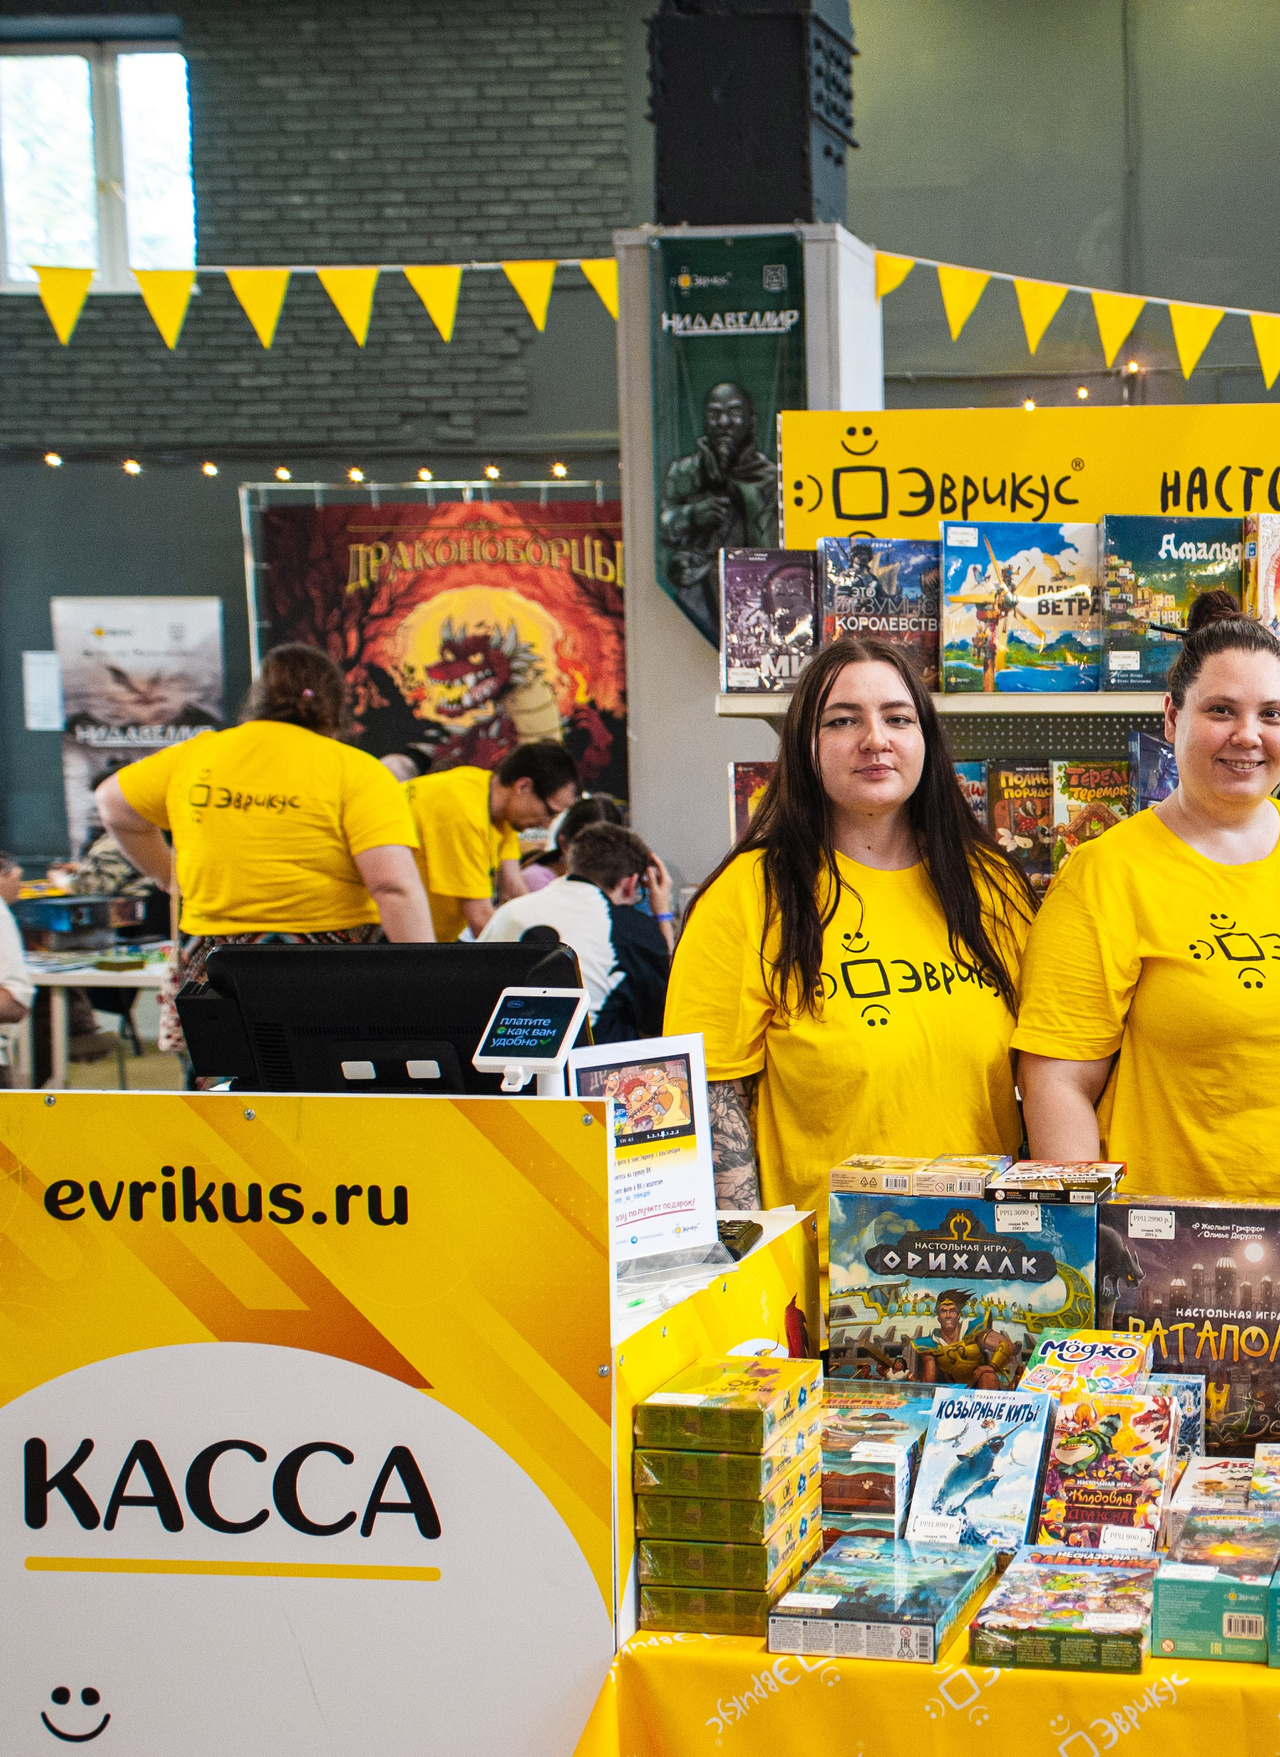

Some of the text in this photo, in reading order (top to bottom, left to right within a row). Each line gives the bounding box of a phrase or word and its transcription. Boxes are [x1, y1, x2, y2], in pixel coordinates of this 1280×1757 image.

[898, 466, 1080, 521] Эврикус
[1158, 532, 1244, 563] Амаль
[346, 534, 625, 593] ДРАКОНОБОРЦЫ
[851, 587, 876, 597] ЭТО
[835, 599, 939, 615] БЕЗУМНО
[835, 617, 940, 631] КОРОЛЕВСТВ
[999, 771, 1051, 788] ПОЛНЫ
[213, 787, 300, 815] Эврикус
[1004, 788, 1051, 799] ПОРЯДО
[895, 959, 1002, 998] Эврику
[500, 1017, 551, 1027] платите
[490, 1035, 539, 1047] удобно
[507, 1028, 557, 1037] как вам
[44, 1166, 409, 1227] evrikus.ru
[628, 1197, 696, 1219] получите подарок!
[1201, 1223, 1230, 1231] Жюльен
[914, 1242, 1008, 1253] НАСТОЛЬНАЯ ИГРА
[882, 1252, 1038, 1276] ОРИХАЛК
[1176, 1307, 1252, 1320] НАСТОЛЬНАЯ
[936, 1400, 1041, 1423] КОЗЫРНЫЕ КИТЫ
[24, 1437, 443, 1540] КАССА
[1089, 1670, 1191, 1750] Эврикус
